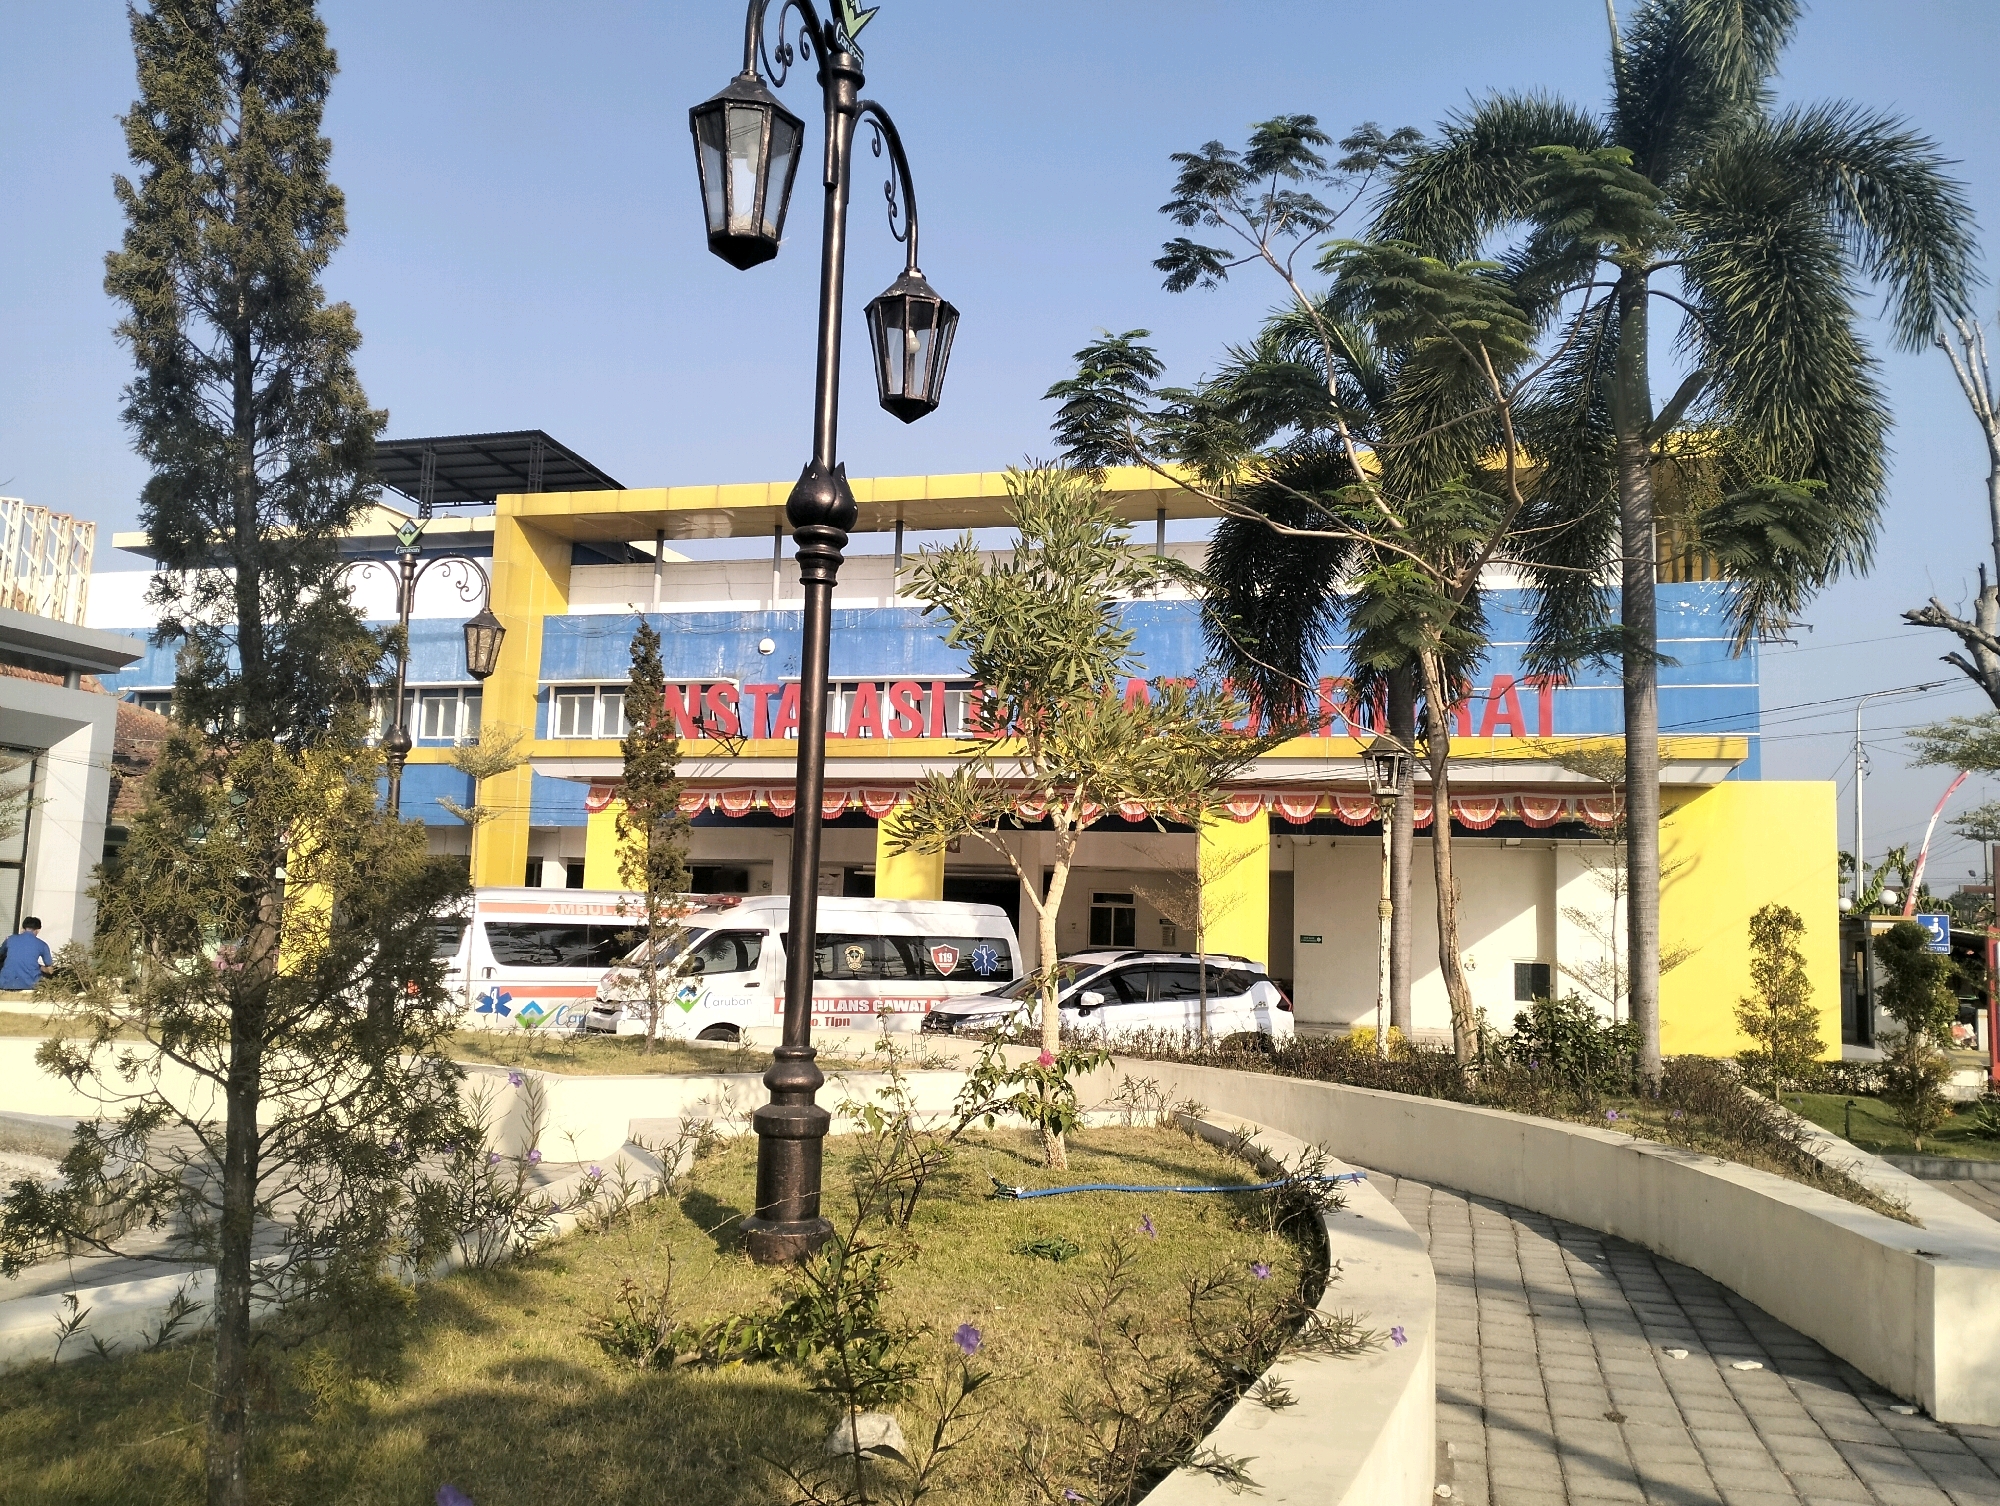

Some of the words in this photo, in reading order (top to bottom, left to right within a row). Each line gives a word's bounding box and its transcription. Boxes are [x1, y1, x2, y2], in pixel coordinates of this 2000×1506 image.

[938, 953, 953, 963] 119
[704, 991, 752, 1008] Caruban
[872, 999, 928, 1012] GAWAT
